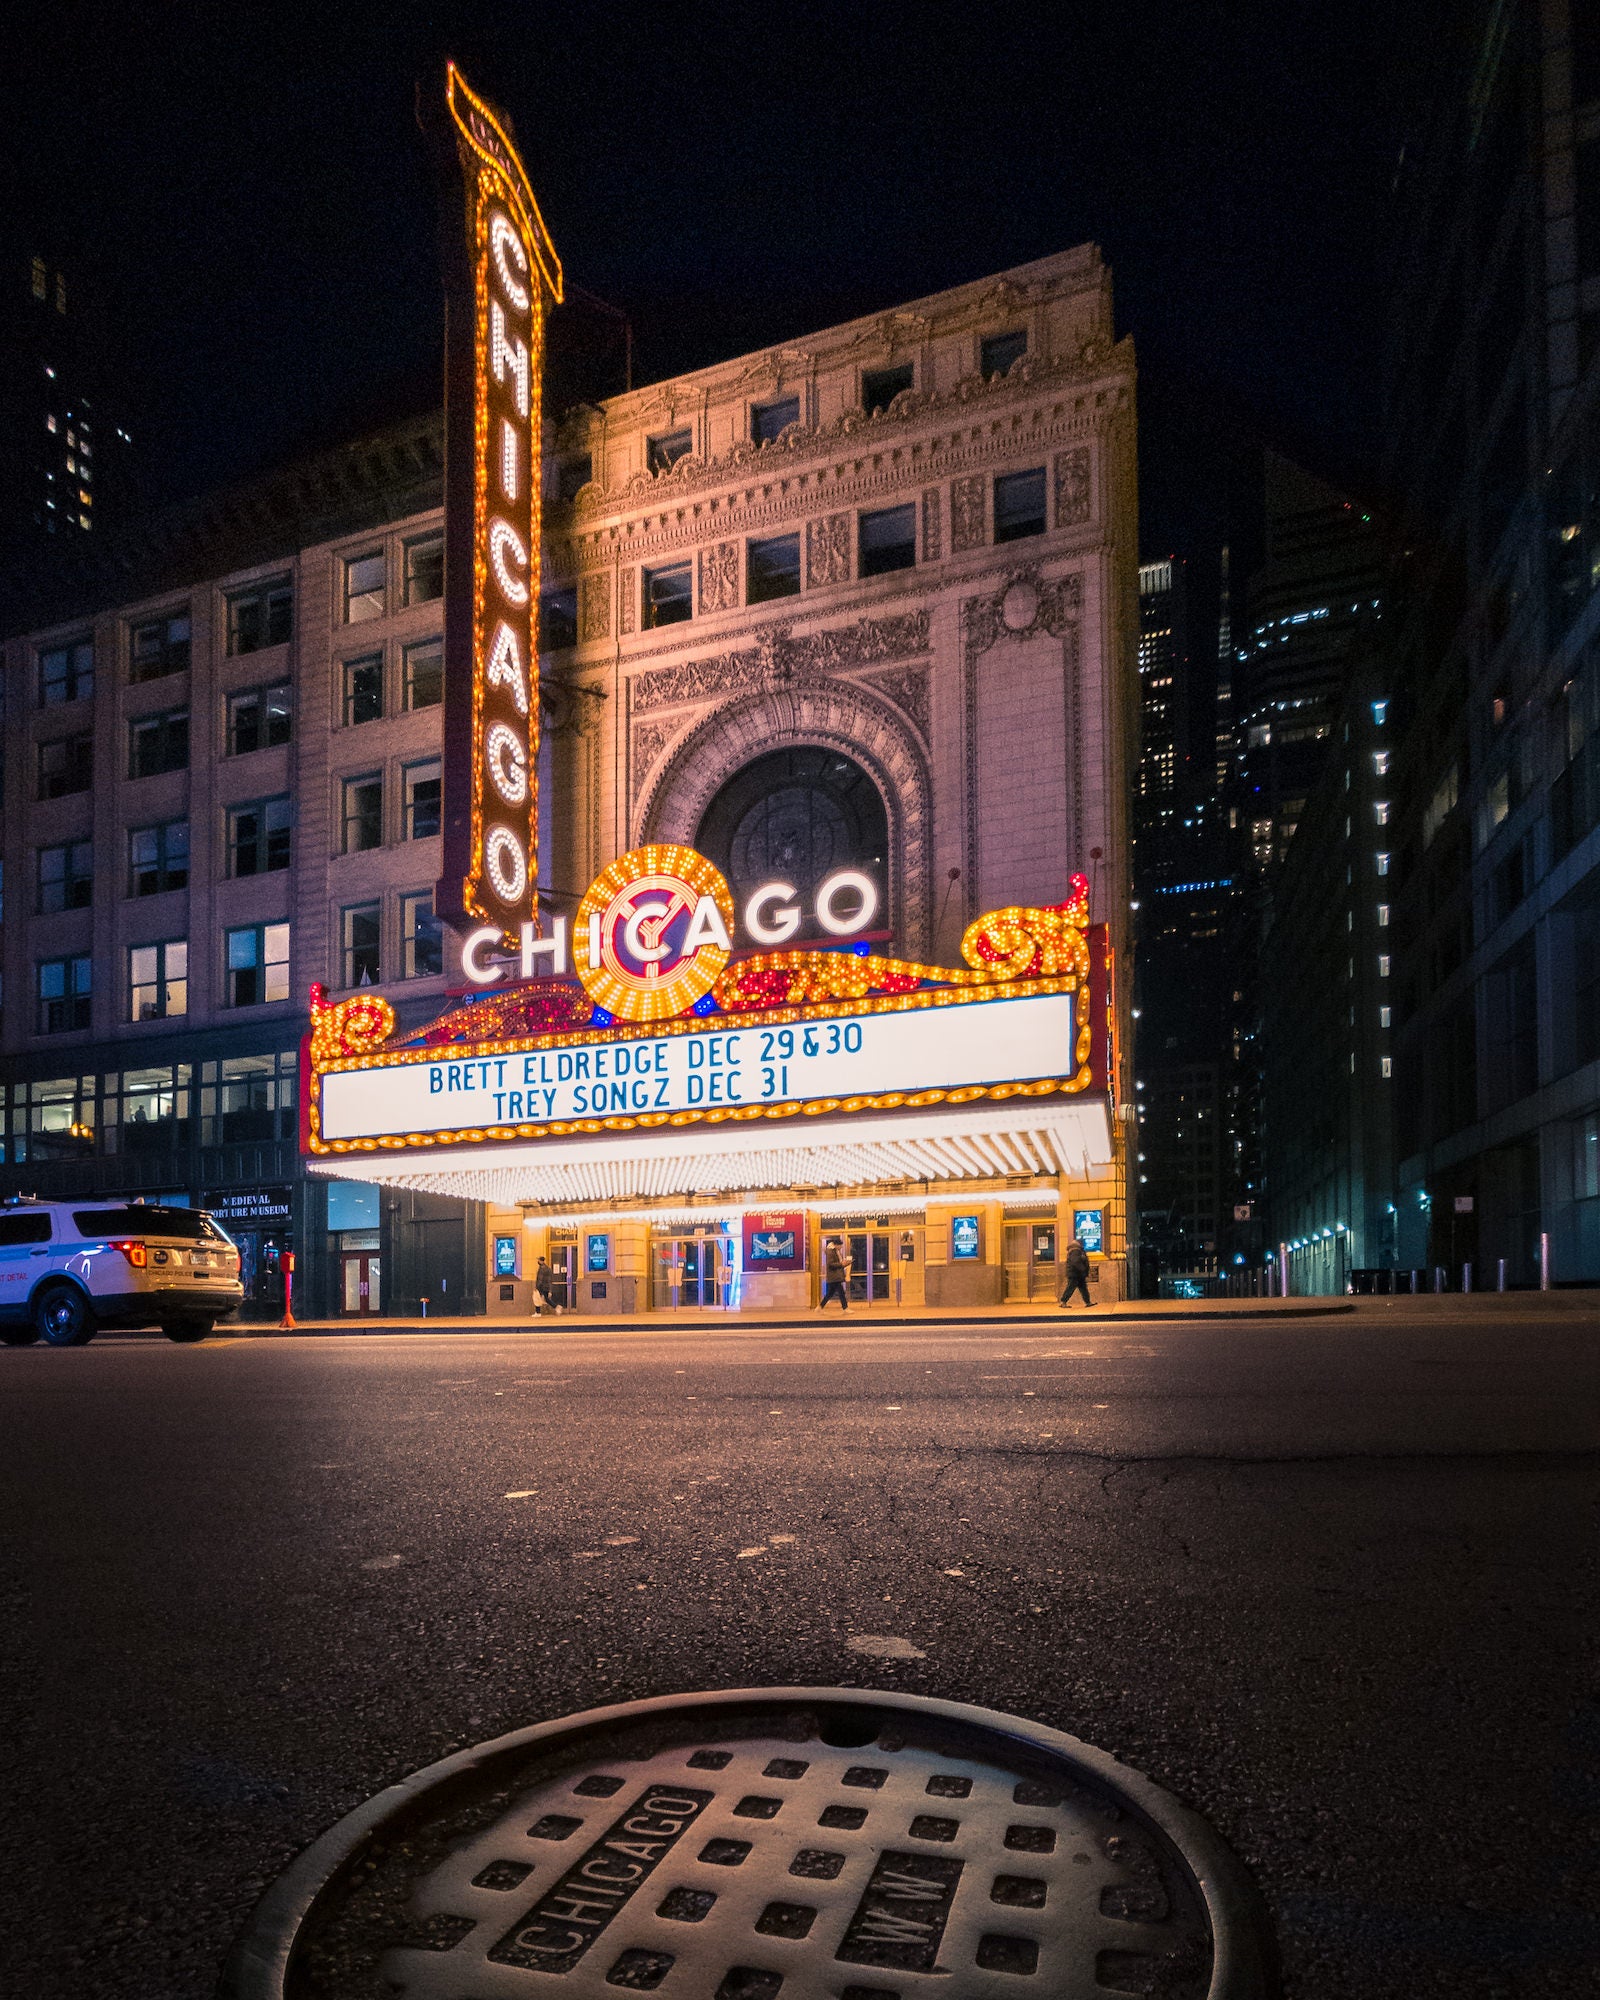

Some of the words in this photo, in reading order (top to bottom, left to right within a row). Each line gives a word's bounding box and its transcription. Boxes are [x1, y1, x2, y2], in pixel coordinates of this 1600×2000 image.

[487, 210, 528, 905] CHICAGO
[461, 871, 878, 984] CHICAGO
[429, 1060, 508, 1095] BRETT
[523, 1042, 669, 1085] ELDREDGE
[688, 1035, 741, 1066] DEC
[492, 1088, 558, 1121] TREY
[572, 1077, 670, 1114] SONGZ
[687, 1071, 742, 1104] DEC
[761, 1065, 789, 1097] 31
[209, 1207, 248, 1219] ORTURE
[250, 1205, 289, 1217] MUSEUM
[222, 1194, 270, 1206] MEDIEVAL
[7, 1272, 28, 1281] DETAIL
[514, 1796, 700, 1955] CHICAGO
